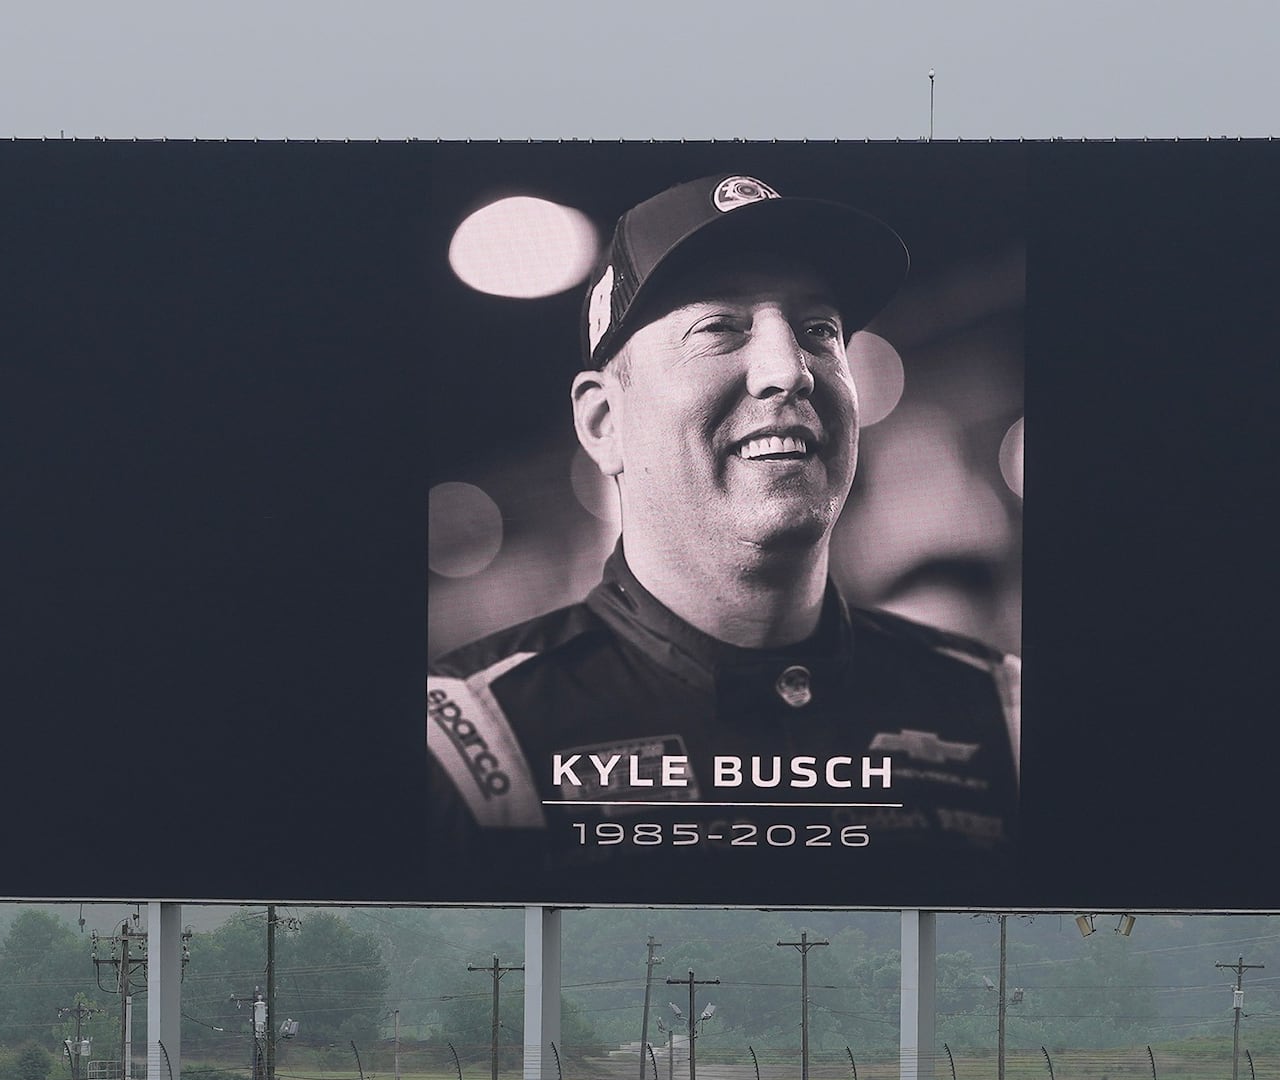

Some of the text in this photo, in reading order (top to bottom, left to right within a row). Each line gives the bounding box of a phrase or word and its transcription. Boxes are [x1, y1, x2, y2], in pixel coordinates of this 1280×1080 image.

[552, 753, 689, 788] KYLE
[713, 754, 893, 789] BUSCH
[571, 822, 871, 848] 1985-2026
